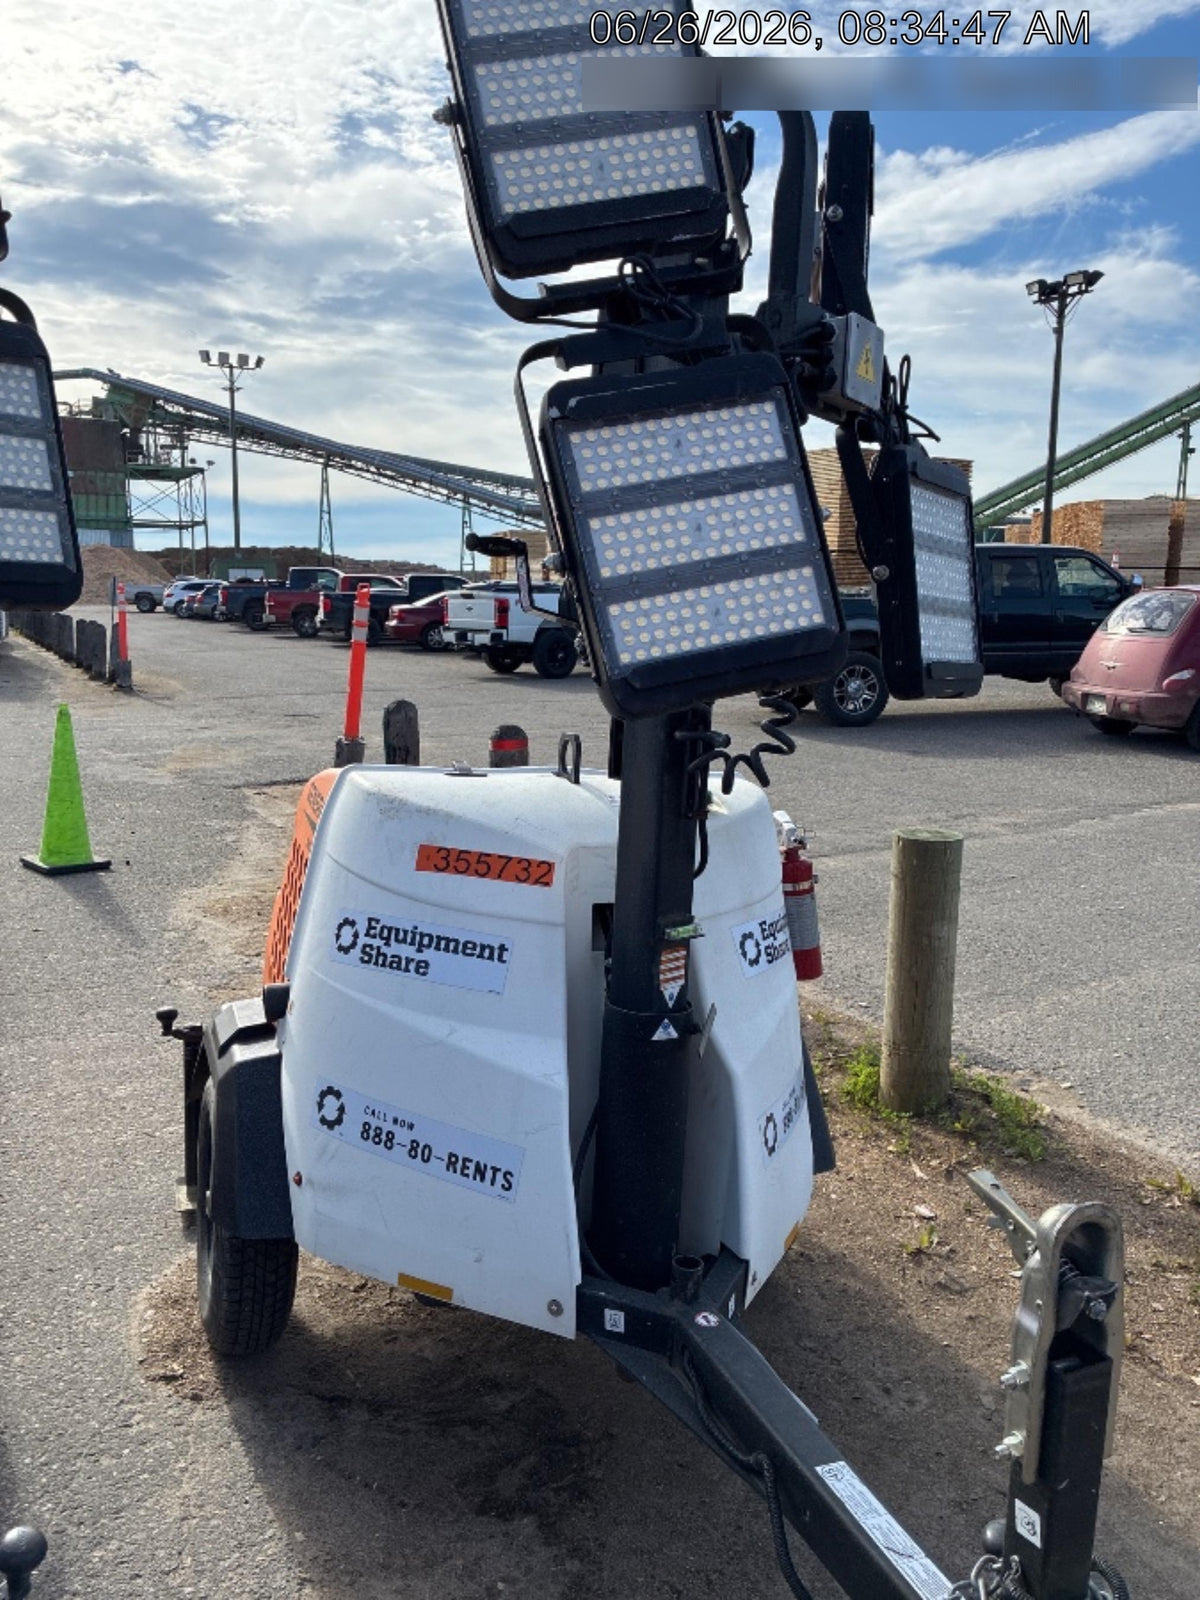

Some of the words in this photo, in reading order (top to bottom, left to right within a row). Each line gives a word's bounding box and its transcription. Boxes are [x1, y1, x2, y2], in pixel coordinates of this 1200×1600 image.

[433, 847, 552, 887] 355732
[358, 942, 431, 977] Share
[363, 917, 510, 965] Equipment
[363, 1104, 388, 1123] CALL
[392, 1116, 415, 1132] NOW
[360, 1121, 515, 1192] 888-80-RENTS
